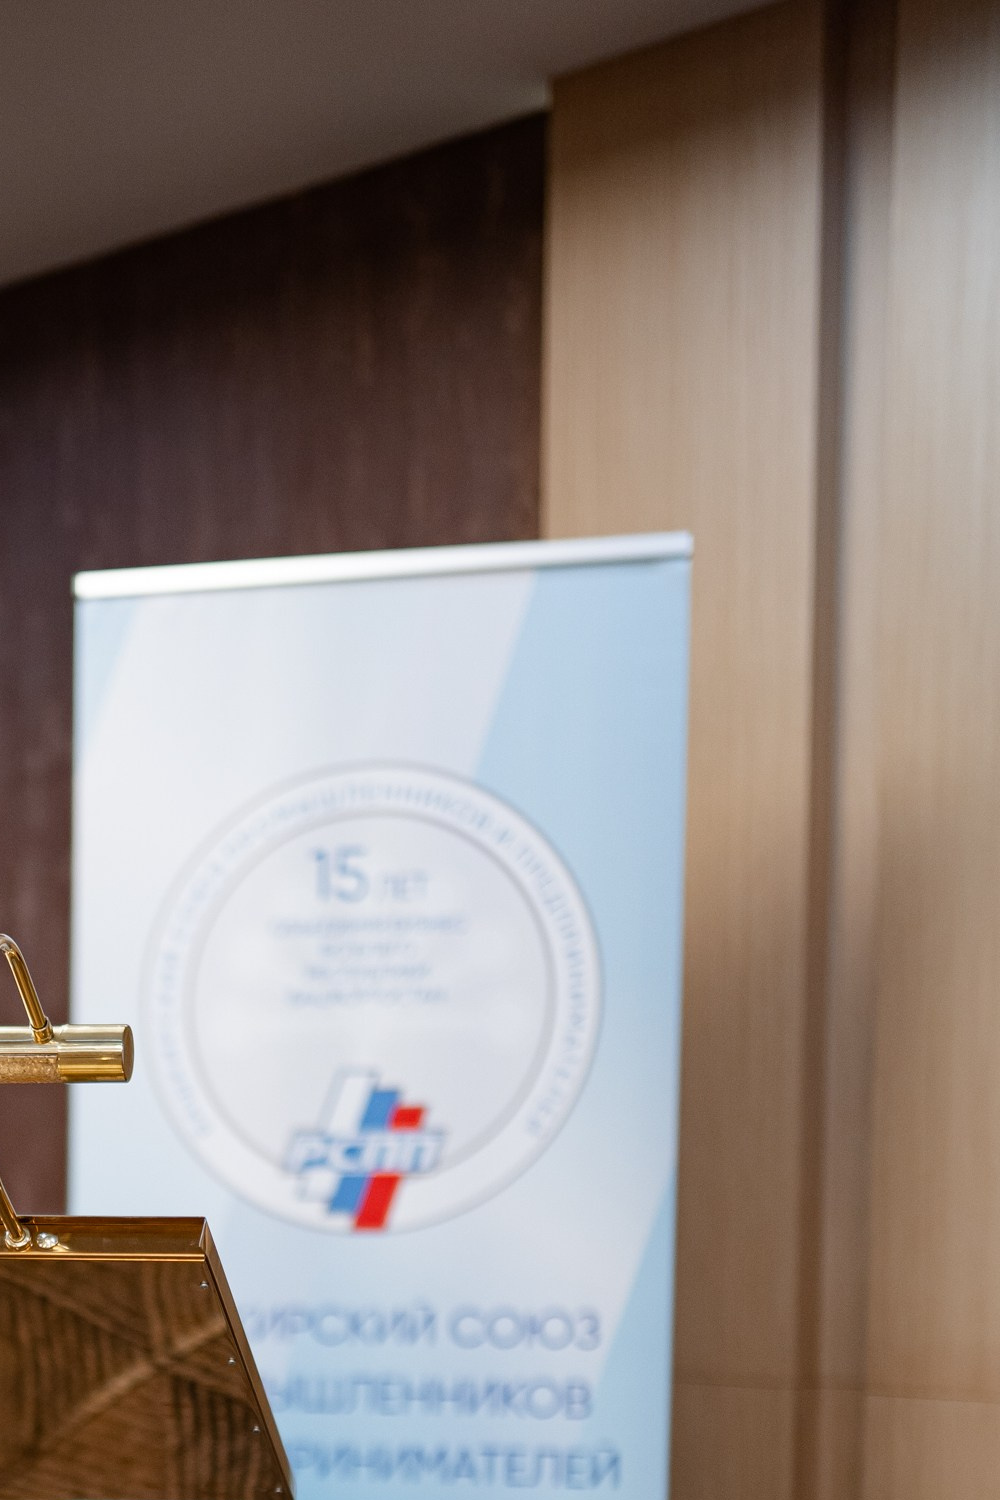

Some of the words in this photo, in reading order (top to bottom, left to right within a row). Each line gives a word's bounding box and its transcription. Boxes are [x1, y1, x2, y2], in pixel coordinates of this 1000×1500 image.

[311, 844, 371, 904] 15
[238, 1297, 438, 1346] ИРСКИЙ
[446, 1304, 602, 1352] СОЮЗ
[264, 1372, 595, 1422] ЫШЛЕННИКОВ
[288, 1437, 623, 1490] РИНИМАТЕЛЕЙ
